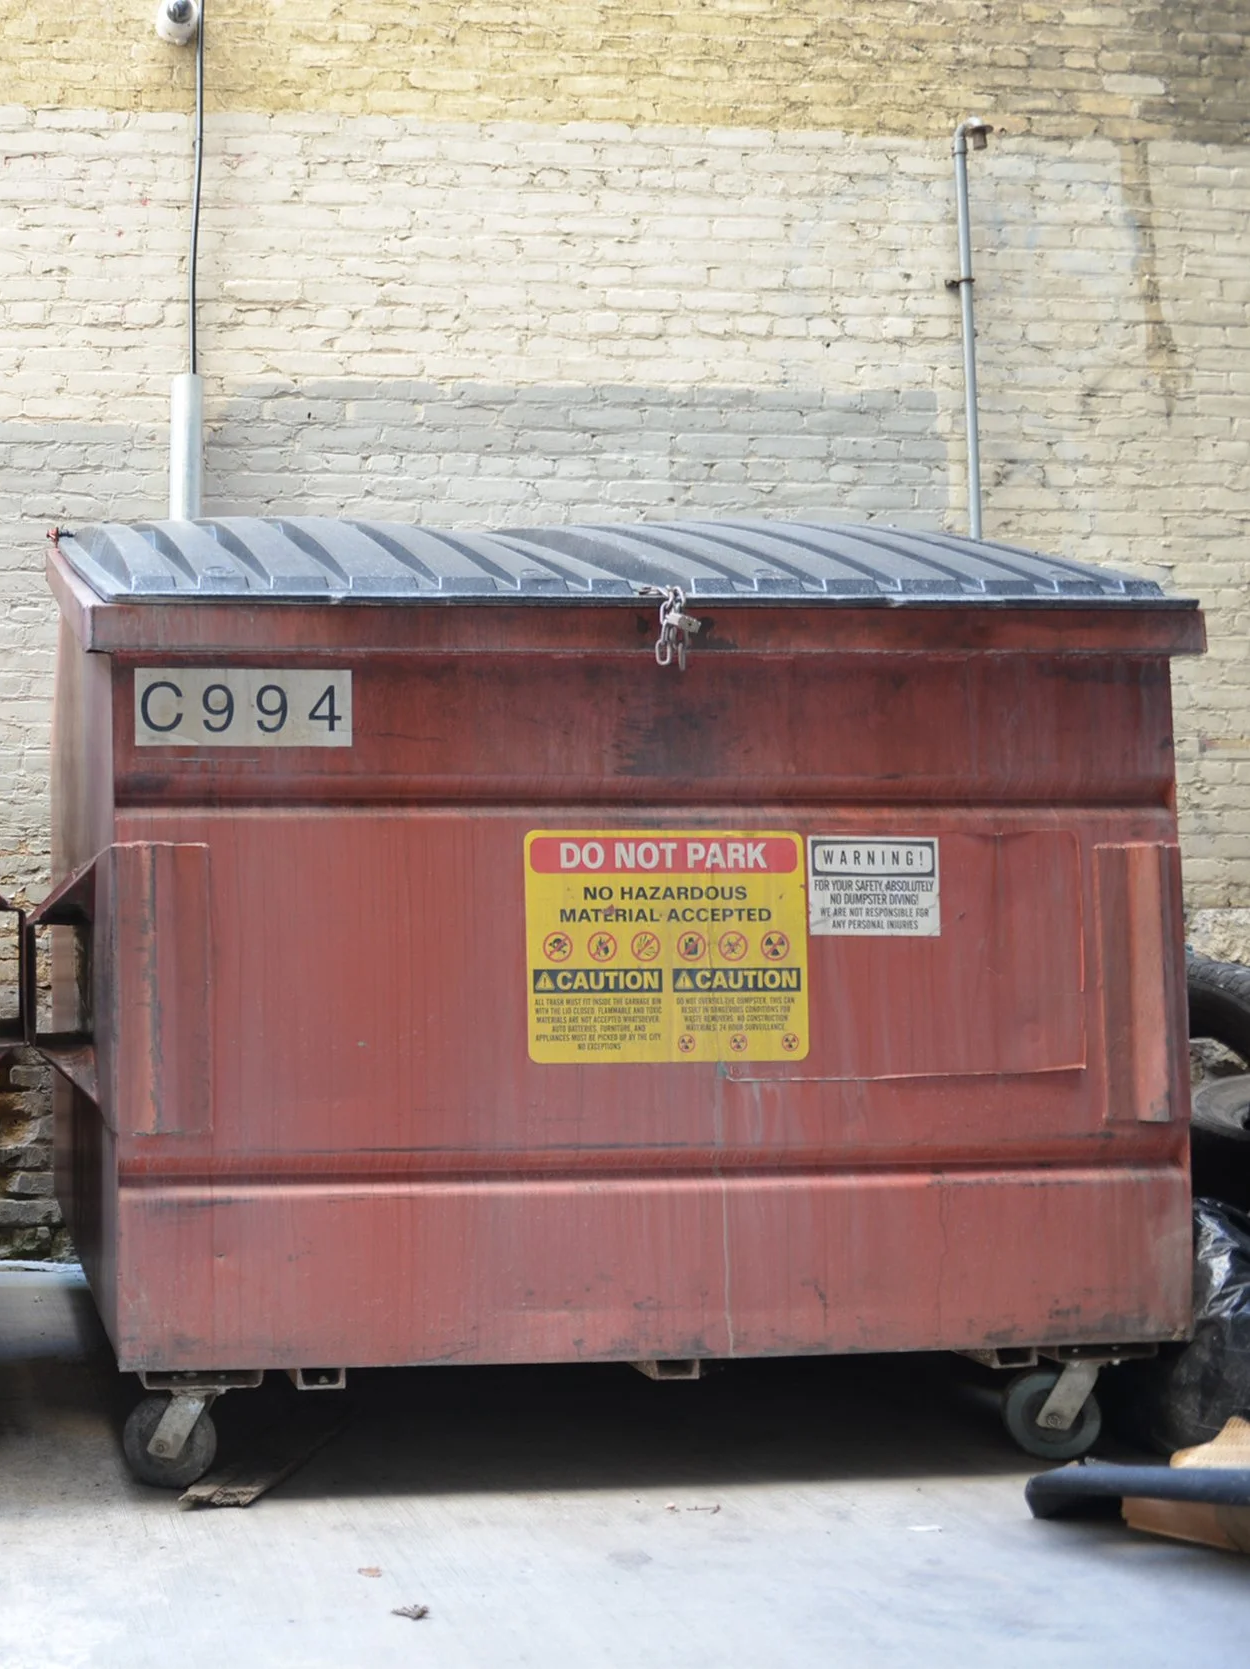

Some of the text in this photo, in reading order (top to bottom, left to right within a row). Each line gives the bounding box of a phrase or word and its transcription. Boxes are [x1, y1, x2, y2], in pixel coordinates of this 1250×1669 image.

[141, 681, 342, 732] C994
[560, 842, 767, 868] DO NOT PARK
[824, 850, 922, 866] WARNING!
[584, 886, 748, 900] NO HAZARDOUS
[815, 880, 829, 891] FOR
[832, 880, 852, 891] YOUR
[885, 881, 934, 892] ABSOLUTELY
[830, 894, 919, 904] NO DUMPSTER DIVING!
[560, 908, 771, 922] MATERIAL ACCEPTED
[821, 908, 830, 917] WE
[833, 908, 846, 917] ARE
[850, 908, 863, 917] NOT
[866, 908, 912, 917] RESPONSIBLE
[832, 921, 846, 929] ANY
[850, 921, 884, 929] PERSONAL
[557, 971, 659, 990] CAUTION
[695, 970, 797, 989] CAUTION
